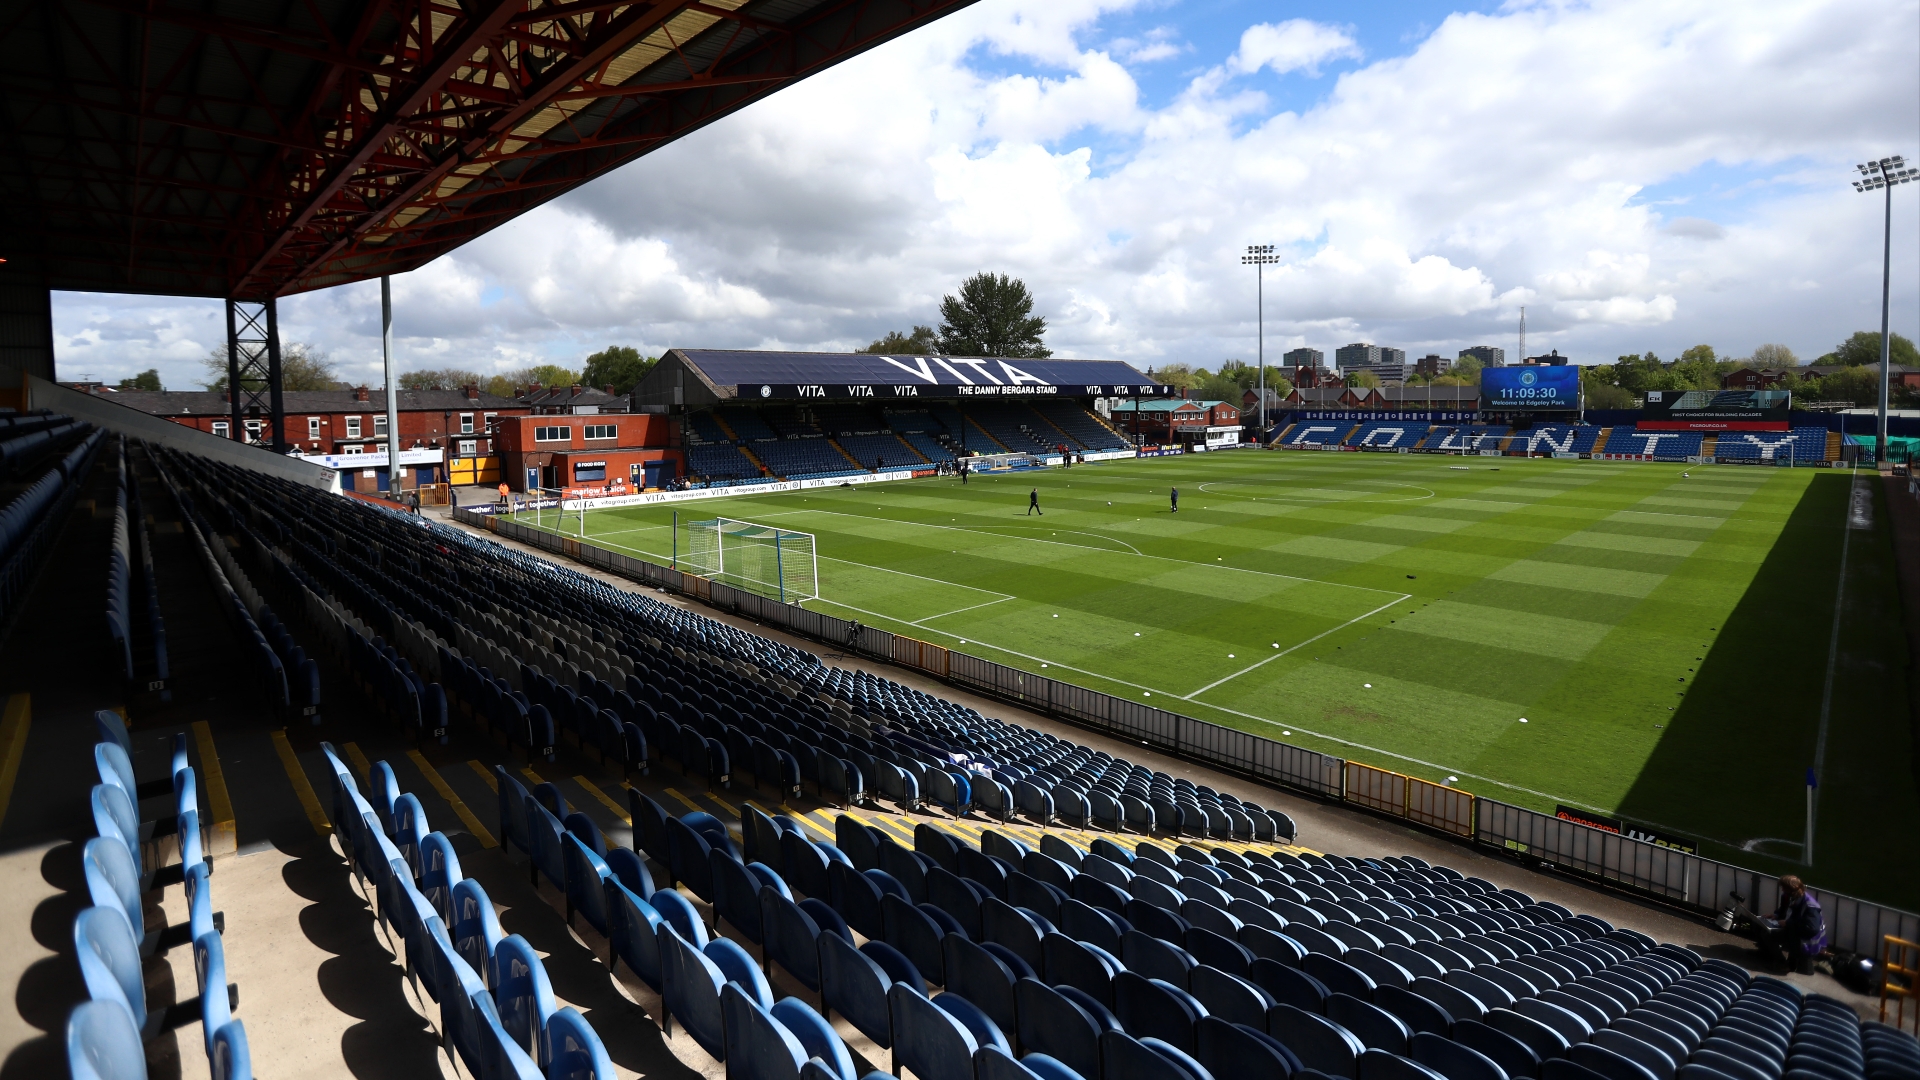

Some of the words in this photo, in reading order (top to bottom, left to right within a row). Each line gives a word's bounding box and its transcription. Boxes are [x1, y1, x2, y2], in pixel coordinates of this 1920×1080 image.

[879, 356, 1051, 385] VITA
[797, 385, 825, 397] VITA
[848, 385, 874, 397] VITA
[894, 385, 918, 396] VITA
[957, 386, 973, 394] THE
[974, 386, 1000, 395] DANNY
[1002, 386, 1035, 394] BERGARA
[1036, 386, 1058, 394] STAND
[1086, 386, 1102, 395] VITA
[1113, 386, 1128, 395] VITA
[1139, 385, 1154, 394] VITA
[1500, 387, 1557, 398] 11:09:30
[771, 482, 787, 490] VITA
[809, 479, 825, 487] VITA
[711, 488, 729, 496] VITA
[734, 486, 766, 494] vitagroup.com
[646, 494, 666, 502] VITA
[671, 491, 706, 499] vitagroup.com
[601, 497, 641, 505] vitagroup.com
[152, 681, 161, 690] U
[436, 728, 443, 736] S
[545, 746, 551, 755] R
